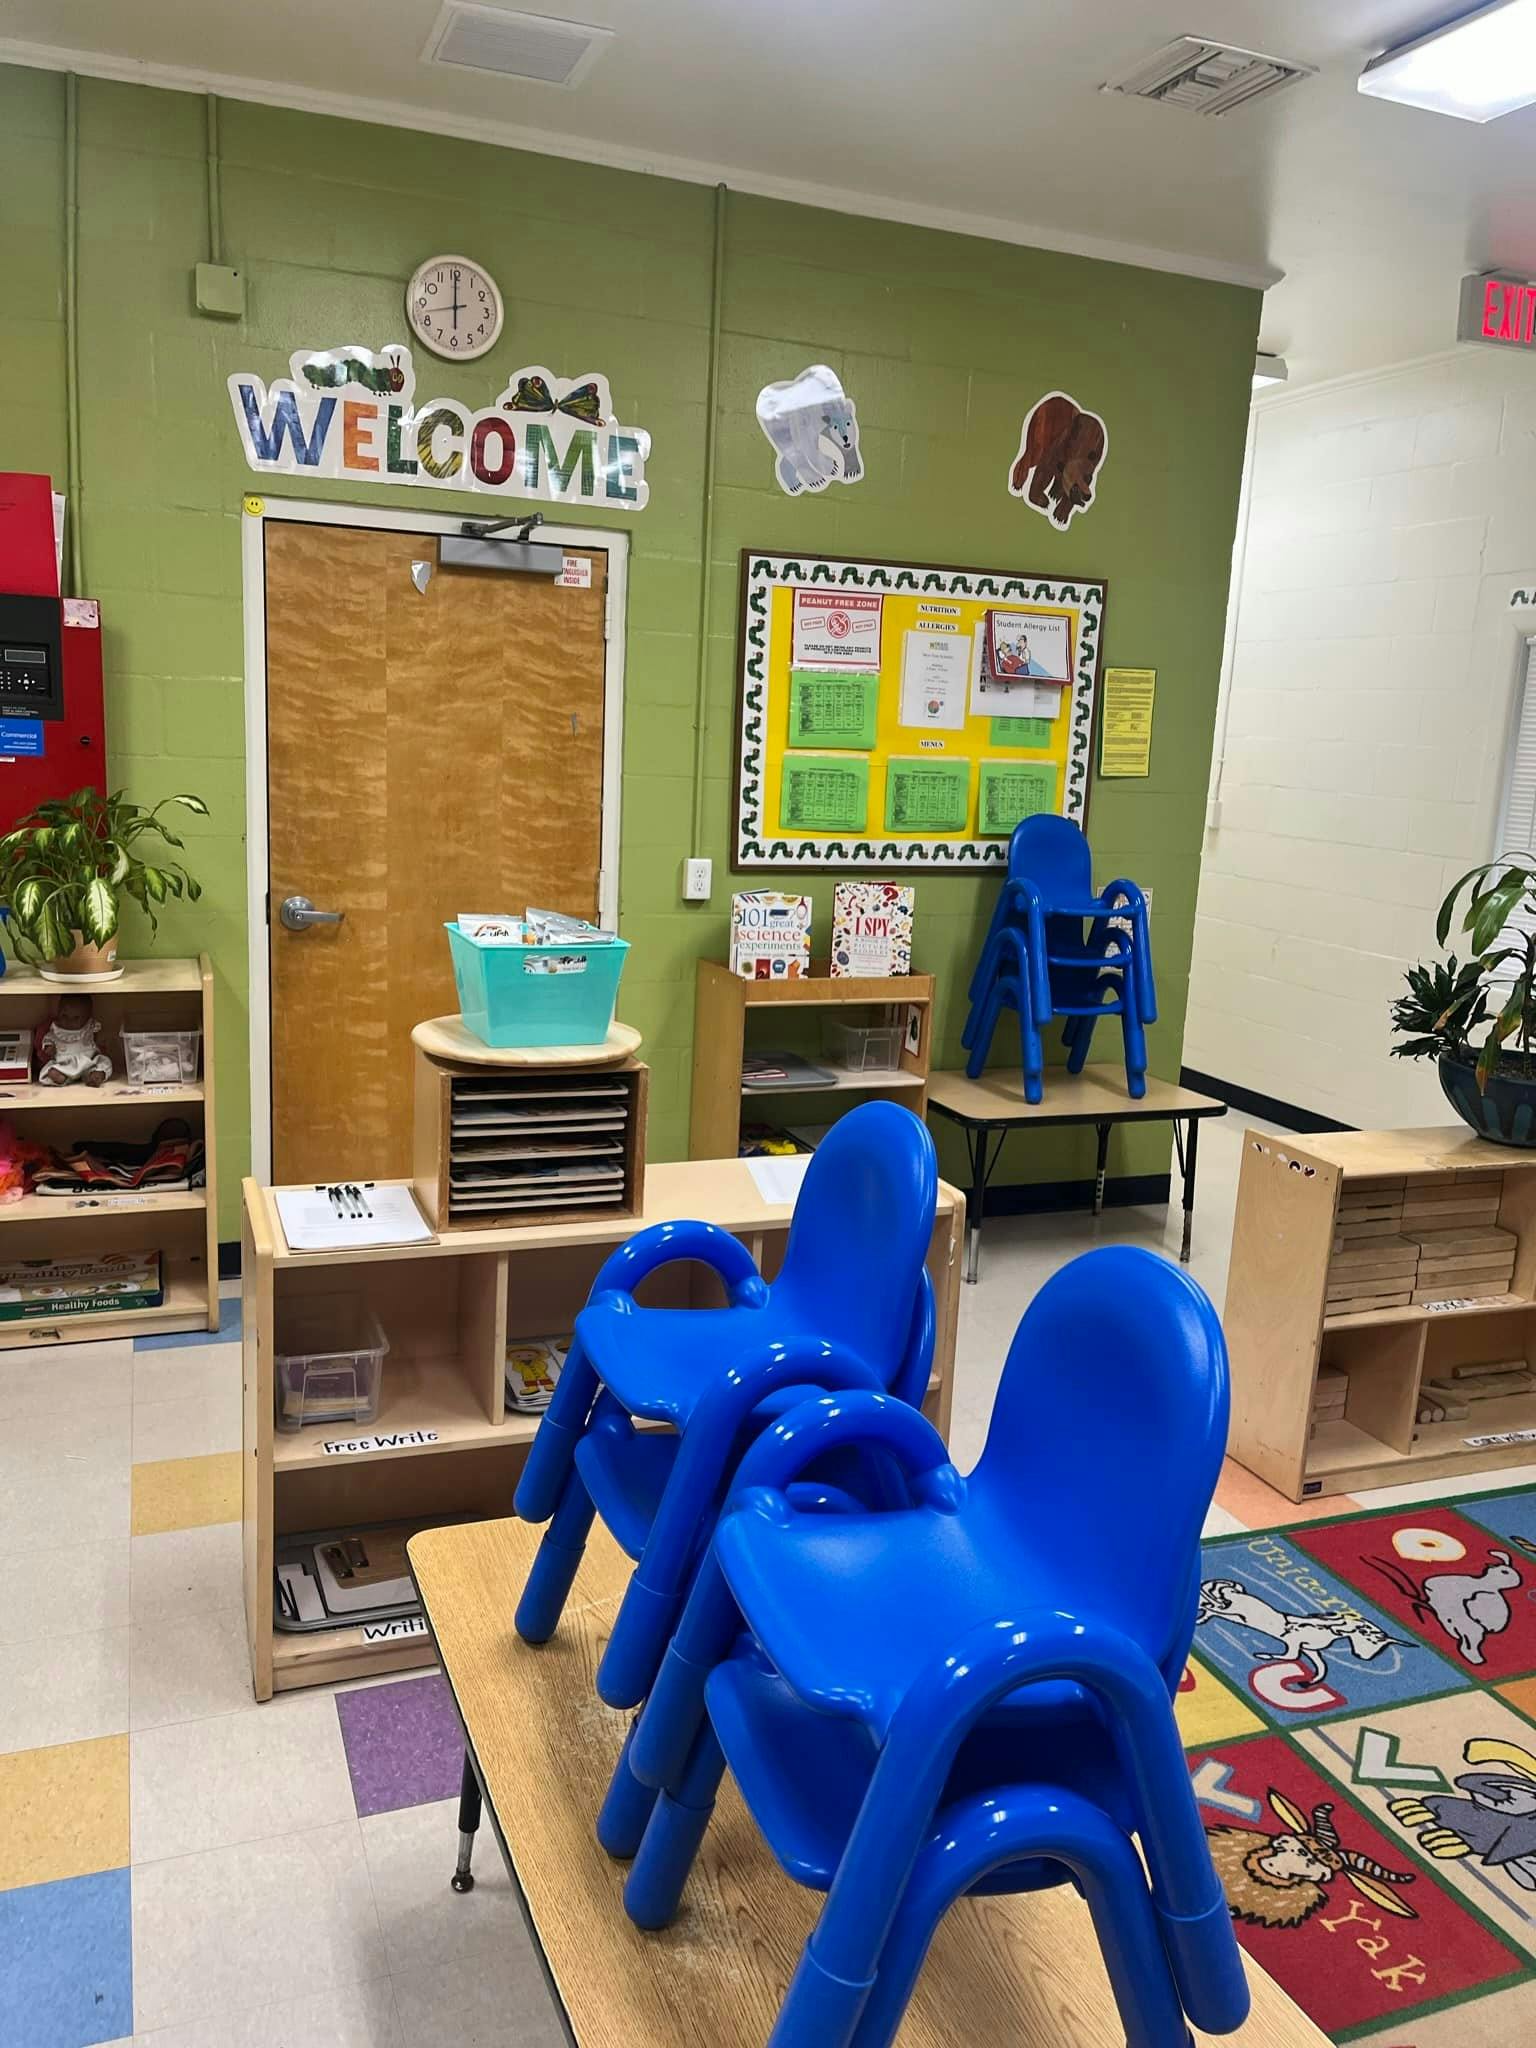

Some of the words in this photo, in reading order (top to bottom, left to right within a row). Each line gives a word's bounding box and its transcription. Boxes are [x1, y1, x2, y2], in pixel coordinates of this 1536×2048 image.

[437, 271, 443, 283] 11
[424, 282, 438, 294] 10
[478, 291, 486, 302] 2
[419, 298, 427, 308] 9
[483, 308, 490, 319] 3
[1482, 281, 1536, 343] EXIT
[424, 315, 431, 326] 8
[437, 328, 443, 340] 7
[477, 323, 484, 335] 4
[450, 335, 458, 347] 6
[467, 333, 473, 344] 5
[238, 384, 642, 502] WELCOME
[801, 597, 832, 606] PEANUT
[835, 599, 854, 607] FREE
[857, 601, 878, 609] ZONE
[920, 604, 957, 614] NUTRITION
[919, 622, 956, 631] ALLERGIES
[1024, 622, 1046, 632] Allergy
[742, 908, 767, 927] 101
[770, 920, 793, 929] great
[856, 917, 860, 935] I
[865, 917, 889, 937] SPY
[739, 926, 801, 941] science
[740, 943, 801, 951] experiments
[51, 1299, 89, 1311] Healthy
[92, 1298, 120, 1308] Foods
[1247, 1535, 1364, 1621] Unicorn
[1319, 1900, 1427, 1991] Yak
